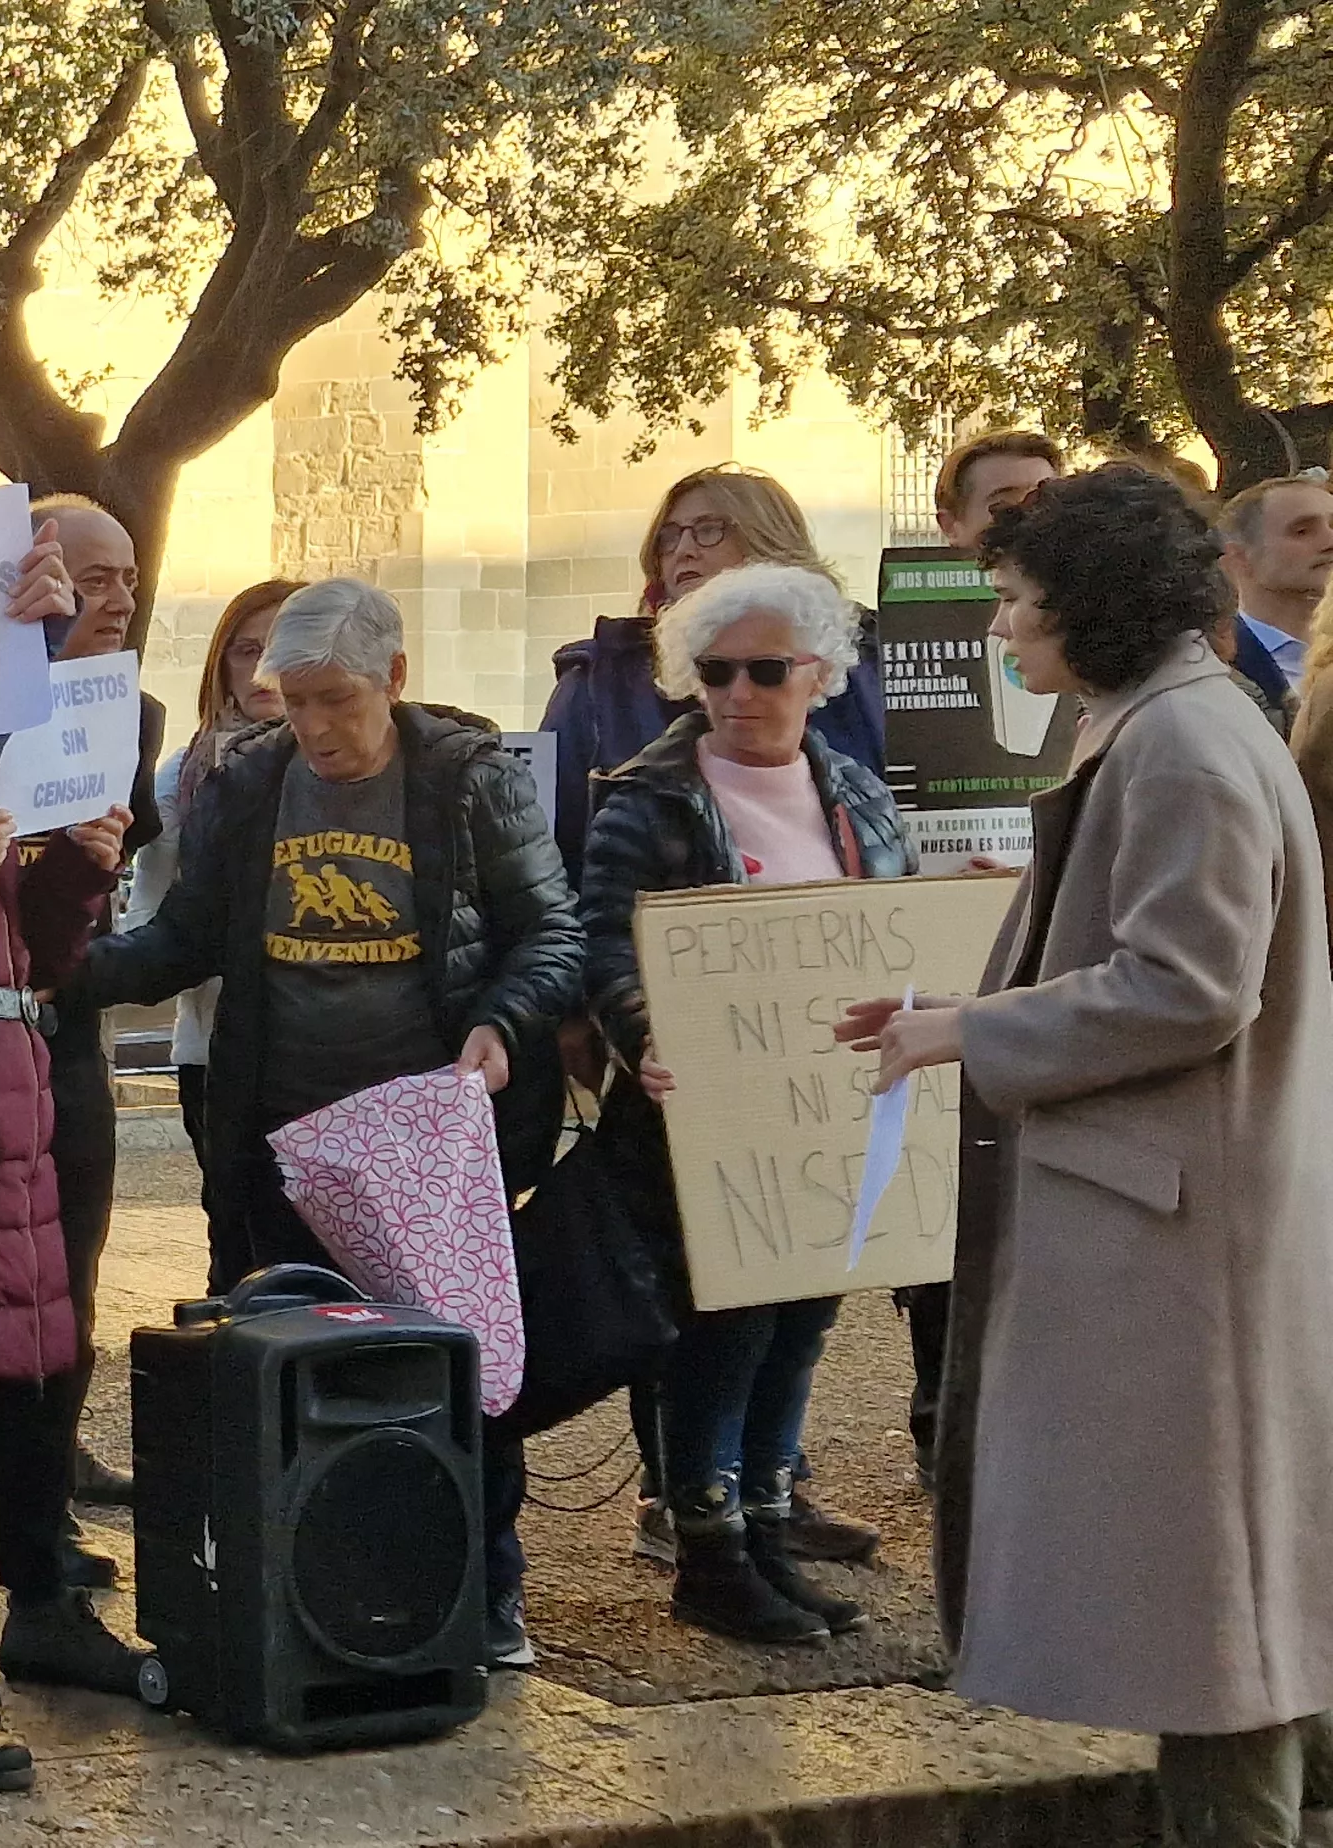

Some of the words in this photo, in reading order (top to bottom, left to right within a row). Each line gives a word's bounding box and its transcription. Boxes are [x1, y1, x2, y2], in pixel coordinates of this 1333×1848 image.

[927, 570, 981, 588] QUIEREN
[883, 640, 982, 661] ENTIERRO
[884, 662, 915, 678] POR
[923, 661, 942, 676] LA
[884, 674, 969, 694] COOPERACIÓN
[885, 693, 981, 710] INTERNACIONAL
[61, 726, 89, 756] SIN
[33, 771, 106, 809] CENSURA
[917, 820, 931, 833] AL
[936, 817, 986, 832] RECORTE
[991, 818, 1004, 830] EN
[921, 837, 973, 855] HUESCA
[979, 837, 993, 852] ES
[998, 835, 1032, 851] SOLIDA
[664, 906, 917, 978] PERIFERIAS
